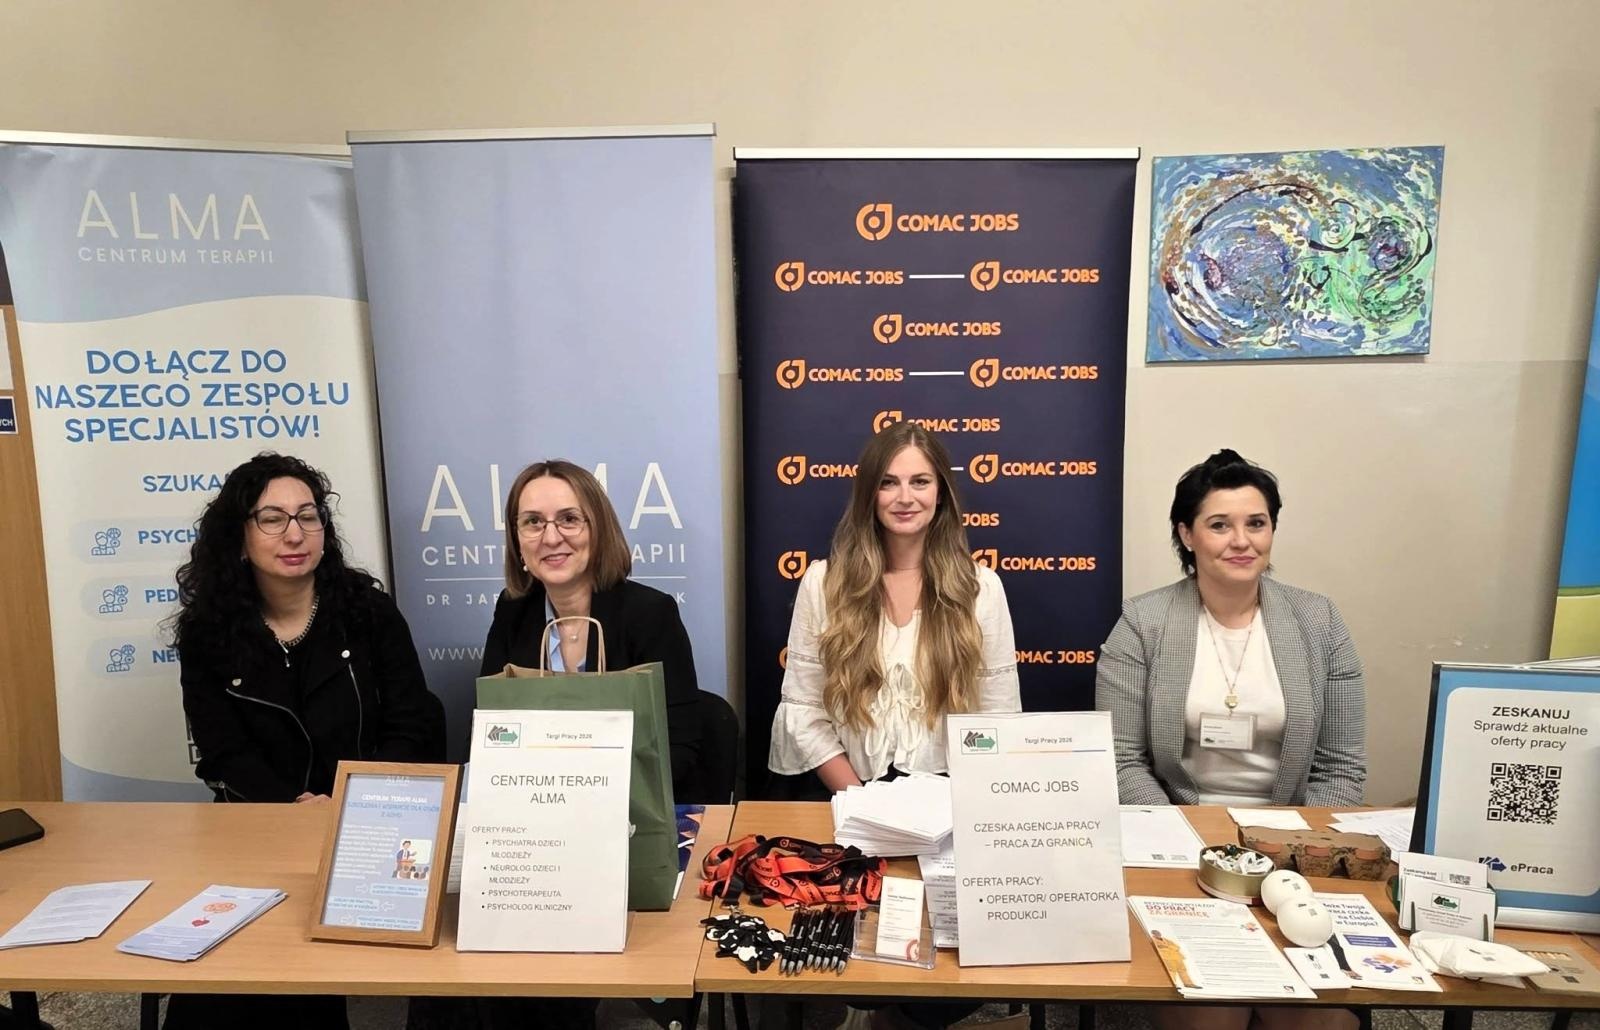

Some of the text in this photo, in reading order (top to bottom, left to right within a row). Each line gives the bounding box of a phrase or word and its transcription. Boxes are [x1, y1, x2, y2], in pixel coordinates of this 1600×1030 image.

[77, 190, 270, 240] ALMA
[897, 213, 964, 232] COMAC
[970, 213, 1018, 232] JOBS
[78, 247, 273, 264] CENTRUM TERAPII
[807, 271, 861, 285] COMAC
[865, 271, 903, 284] JOBS
[1003, 269, 1057, 283] COMAC
[1061, 269, 1099, 283] JOBS
[905, 322, 958, 337] COMAC
[963, 322, 1001, 336] JOBS
[86, 350, 286, 380] DOŁĄCZ DO
[808, 368, 861, 382] COMAC
[866, 368, 903, 382] JOBS
[1002, 366, 1056, 380] COMAC
[1060, 366, 1098, 380] JOBS
[35, 382, 349, 409] NASZEGO ZESPOŁU
[65, 408, 320, 442] SPECJALISTÓW!
[962, 418, 1000, 432] JOBS
[1001, 462, 1055, 476] COMAC
[1059, 462, 1097, 475] JOBS
[142, 473, 229, 492] SZUKA
[962, 513, 999, 526] JOBS
[423, 543, 684, 565] CENT APII
[1001, 557, 1096, 571] COMAC JOBS
[427, 594, 450, 605] DR
[1057, 650, 1095, 664] JOBS
[1492, 707, 1571, 720] ZESKANUJ
[1473, 720, 1589, 736] Sprawdź aktualne
[1491, 735, 1567, 751] oferty pracy
[491, 775, 609, 787] CENTRUM TERAPII
[991, 780, 1080, 794] COMAC JOBS
[530, 793, 566, 804] ALMA
[974, 821, 1101, 833] CZESKA AGENCJA PRACY
[492, 839, 536, 847] PSYCHIATRA
[993, 839, 1029, 848] PRACA
[1031, 839, 1044, 848] ZA
[1046, 837, 1093, 848] GRANICĄ
[1510, 863, 1554, 875] ePraca
[962, 876, 1044, 887] OFERTA PRACY:
[488, 889, 561, 897] PSYCHOTERAPEUTA
[986, 892, 1120, 905] OPERATOR/ OPERATORKA
[487, 903, 533, 911] PSYCHOLOG
[987, 910, 1047, 921] PRODUKCJI
